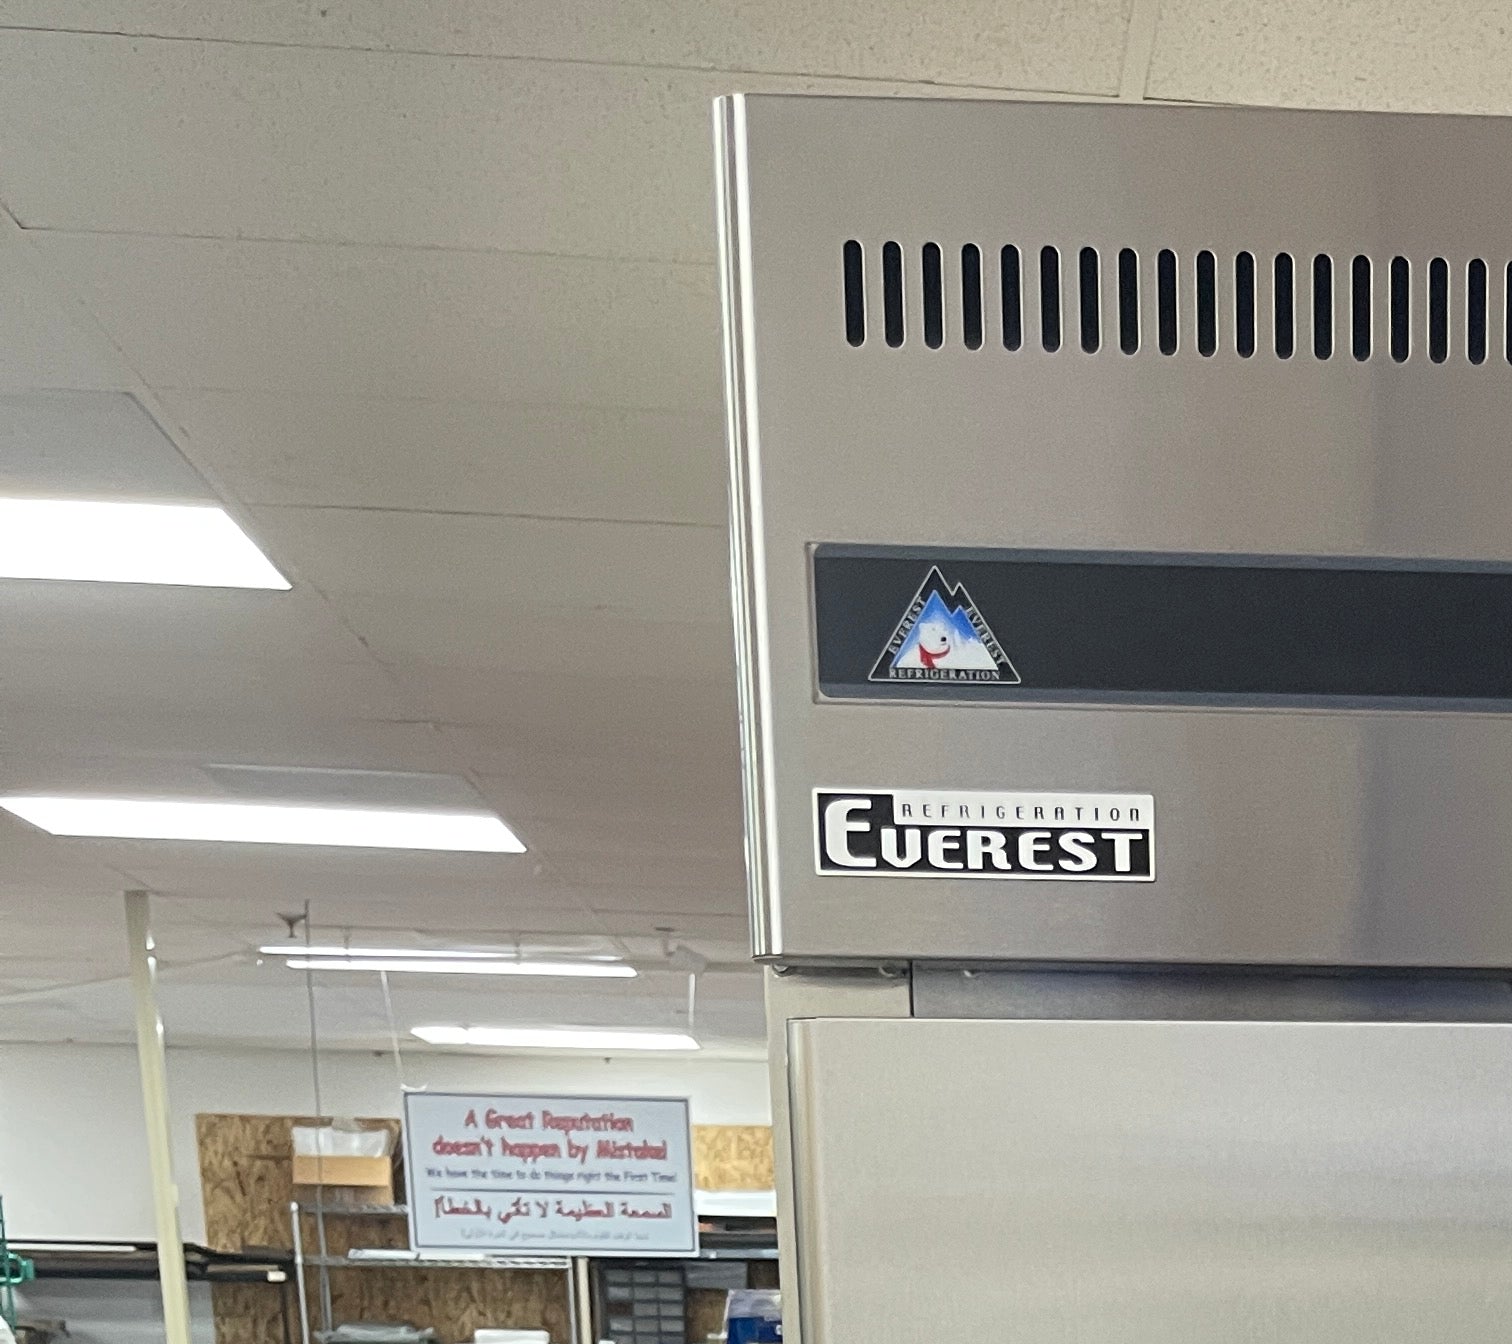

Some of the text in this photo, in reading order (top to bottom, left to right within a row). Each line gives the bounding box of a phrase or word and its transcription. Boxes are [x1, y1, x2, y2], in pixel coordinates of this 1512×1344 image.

[888, 596, 926, 654] EVEREST
[966, 606, 1008, 664] EVEREST
[888, 668, 1001, 681] REFRIGERATION
[902, 803, 1140, 822] REFRIGERATION
[824, 799, 1143, 873] EVEREST
[464, 1107, 634, 1136] A Great Reputation
[432, 1134, 493, 1157] doesn't
[500, 1135, 562, 1164] happen
[567, 1138, 588, 1165] by
[446, 1166, 467, 1178] have
[472, 1168, 487, 1179] the
[491, 1168, 512, 1179] time
[516, 1169, 526, 1180] to
[530, 1168, 540, 1180] do
[544, 1170, 574, 1183] things
[577, 1172, 601, 1184] right
[604, 1171, 620, 1181] the
